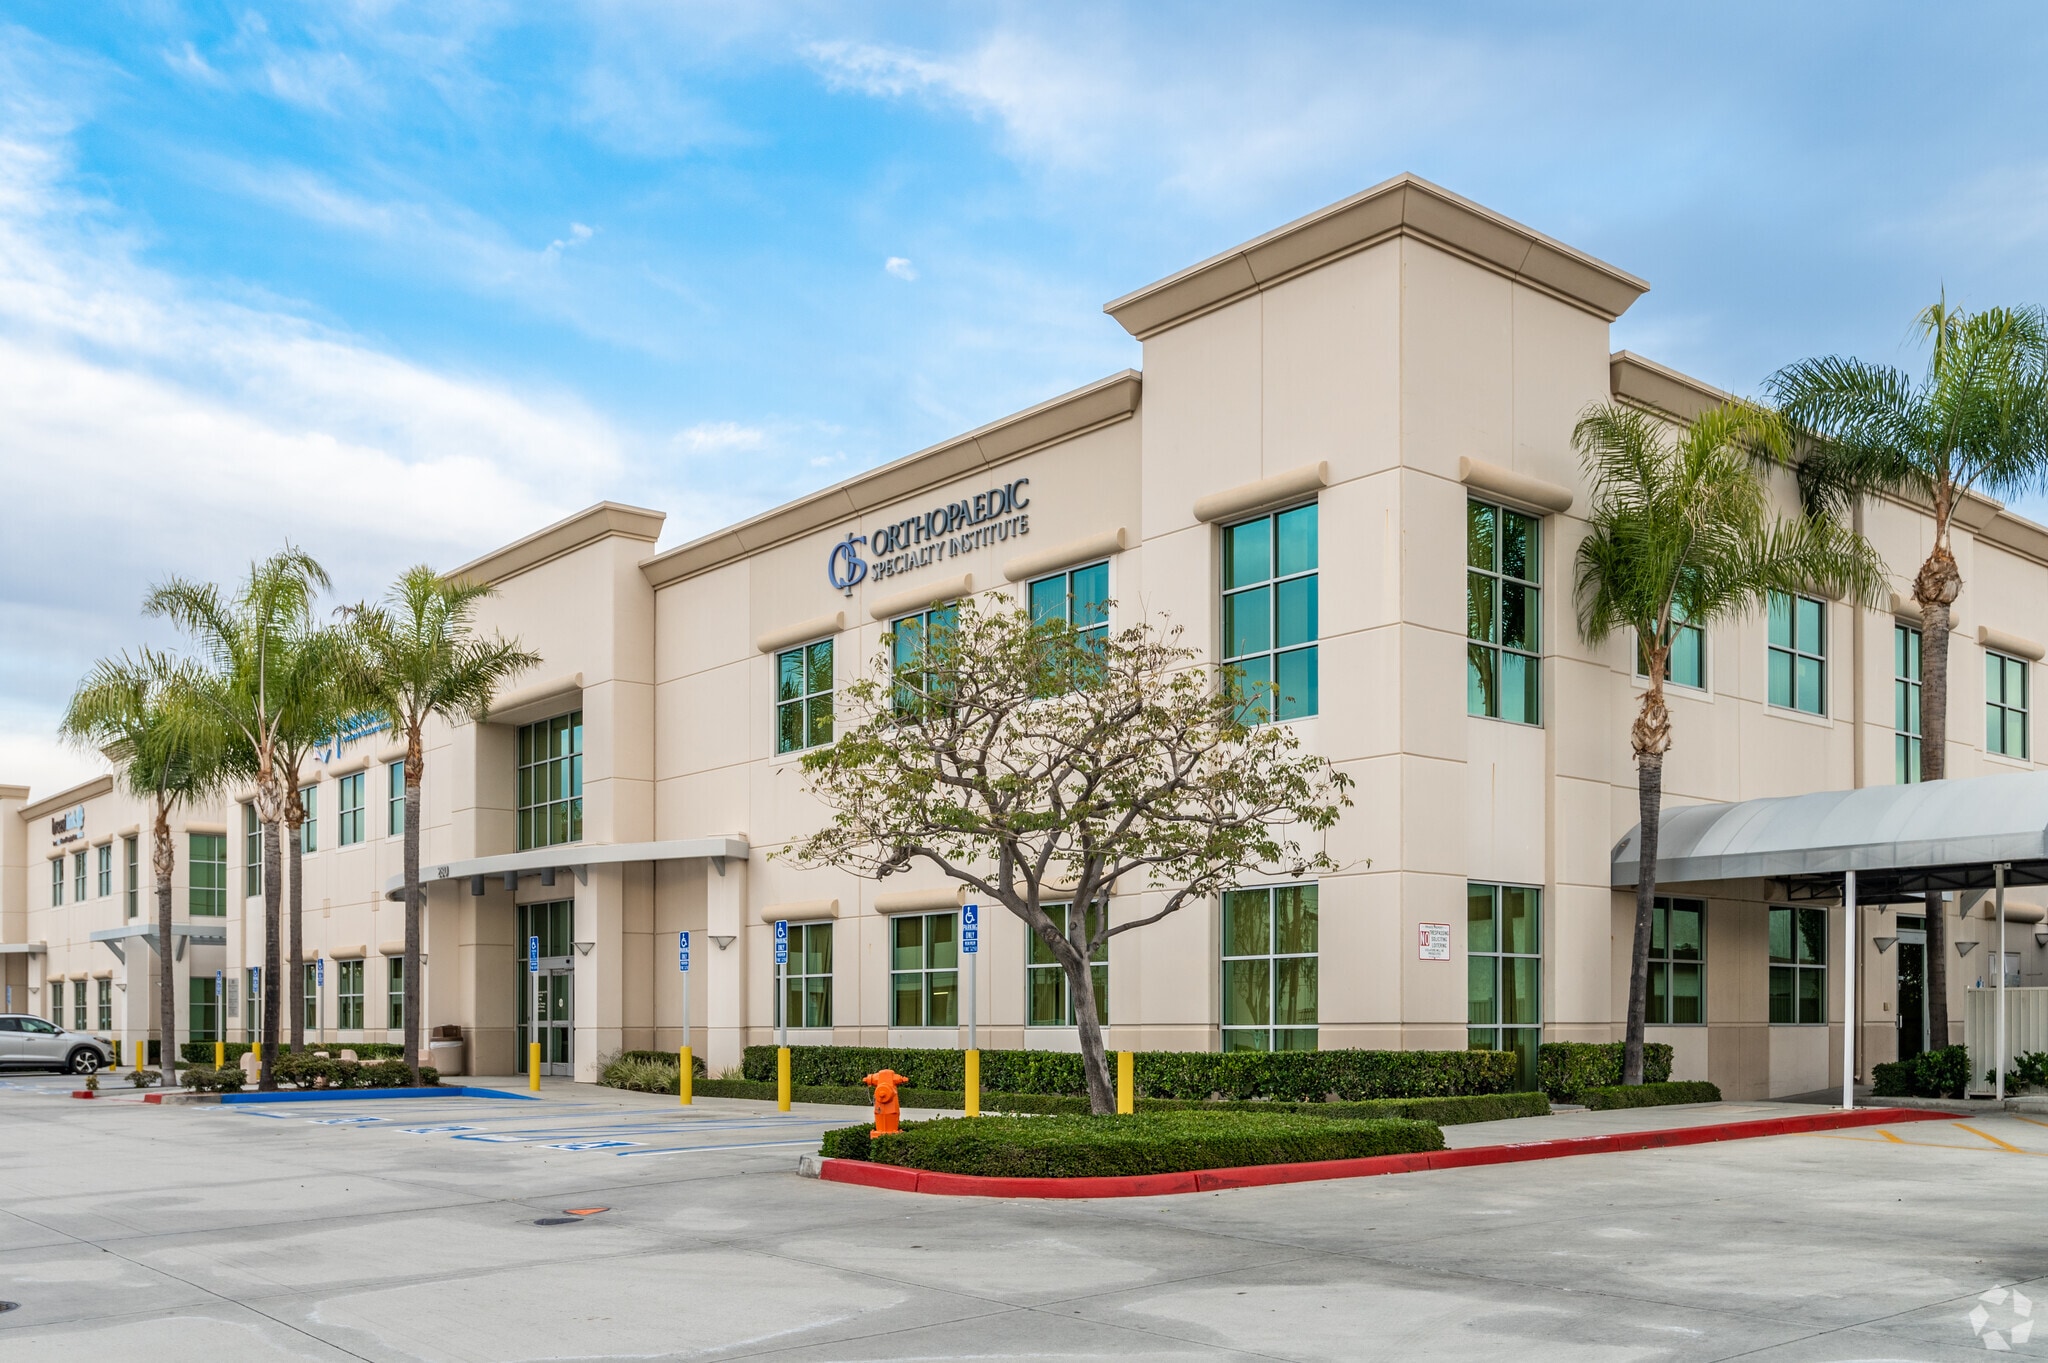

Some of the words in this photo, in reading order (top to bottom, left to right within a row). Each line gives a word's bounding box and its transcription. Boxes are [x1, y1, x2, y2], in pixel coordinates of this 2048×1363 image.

[871, 478, 1030, 557] ORTHOPAEDIC
[871, 541, 946, 581] SPECIALTY
[950, 514, 1029, 557] INSTITUTE
[1421, 931, 1430, 946] NO
